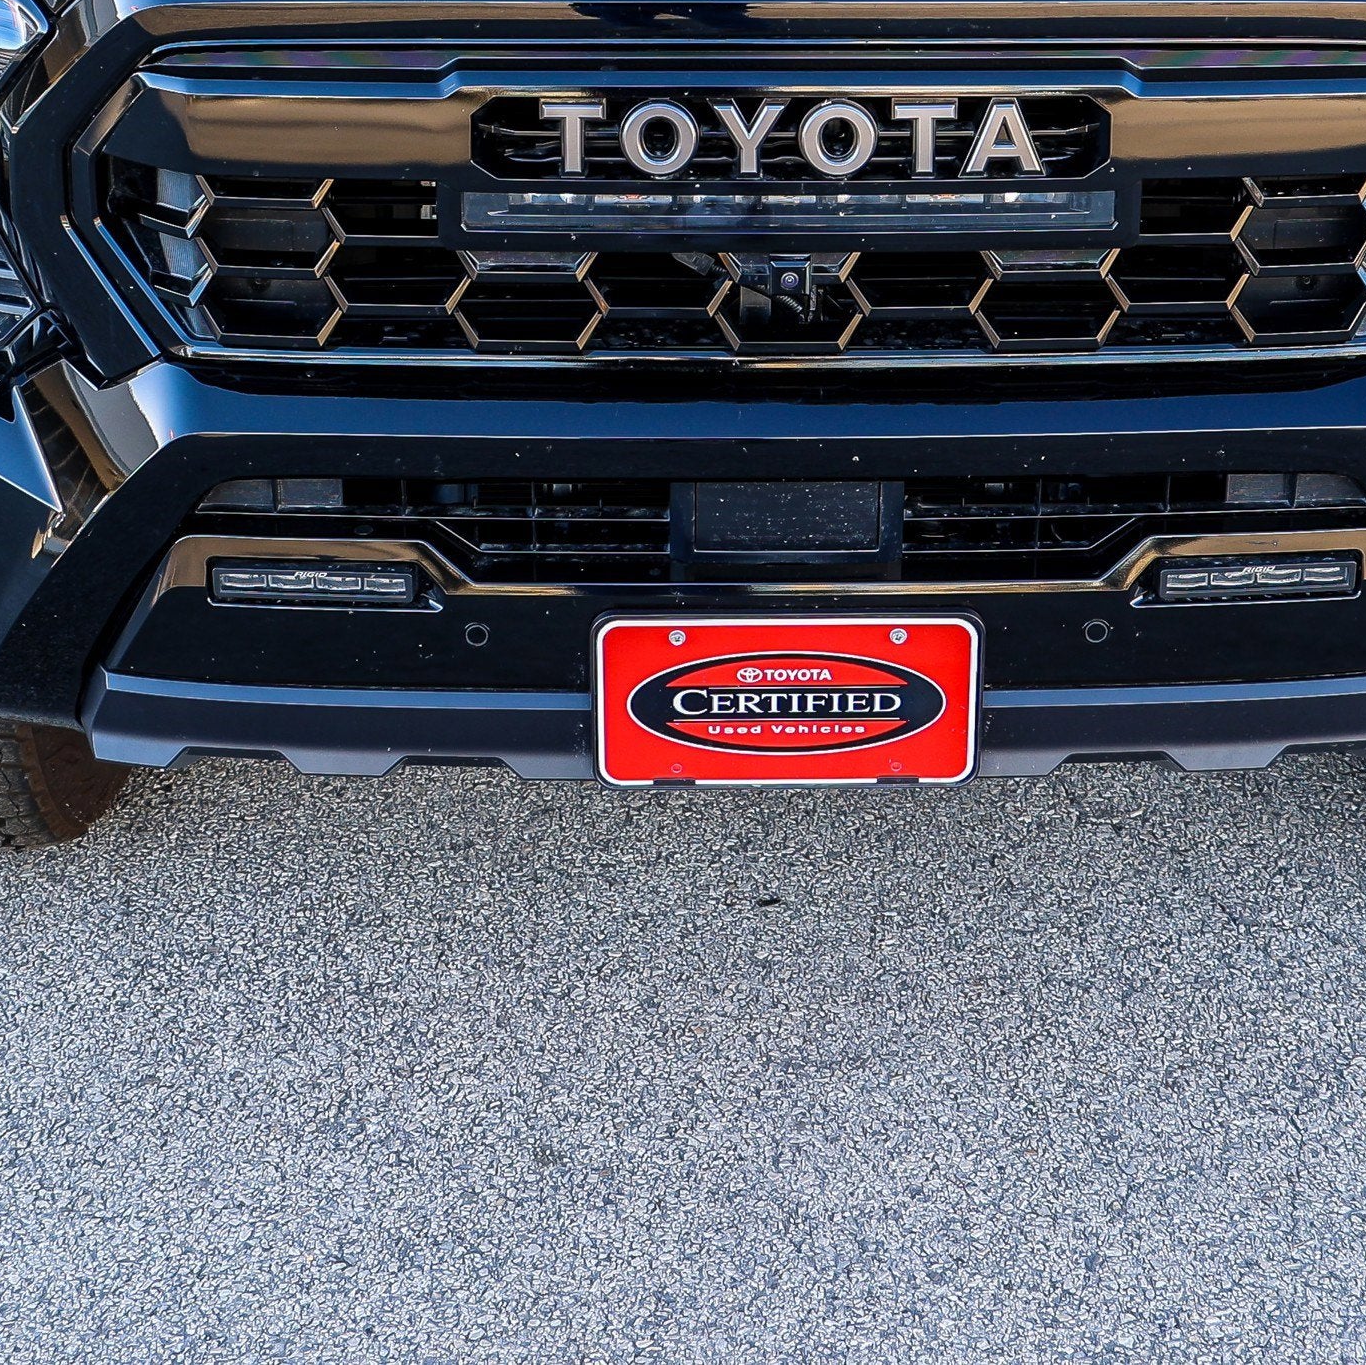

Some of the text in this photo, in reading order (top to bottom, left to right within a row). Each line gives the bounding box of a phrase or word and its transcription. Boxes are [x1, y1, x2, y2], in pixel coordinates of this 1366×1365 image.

[539, 97, 1046, 178] TOYOTA
[1242, 566, 1276, 574] RIGID
[764, 668, 832, 682] TOYOTA
[672, 689, 902, 716] CERTIFIED
[708, 724, 866, 735] Used Vehicles
